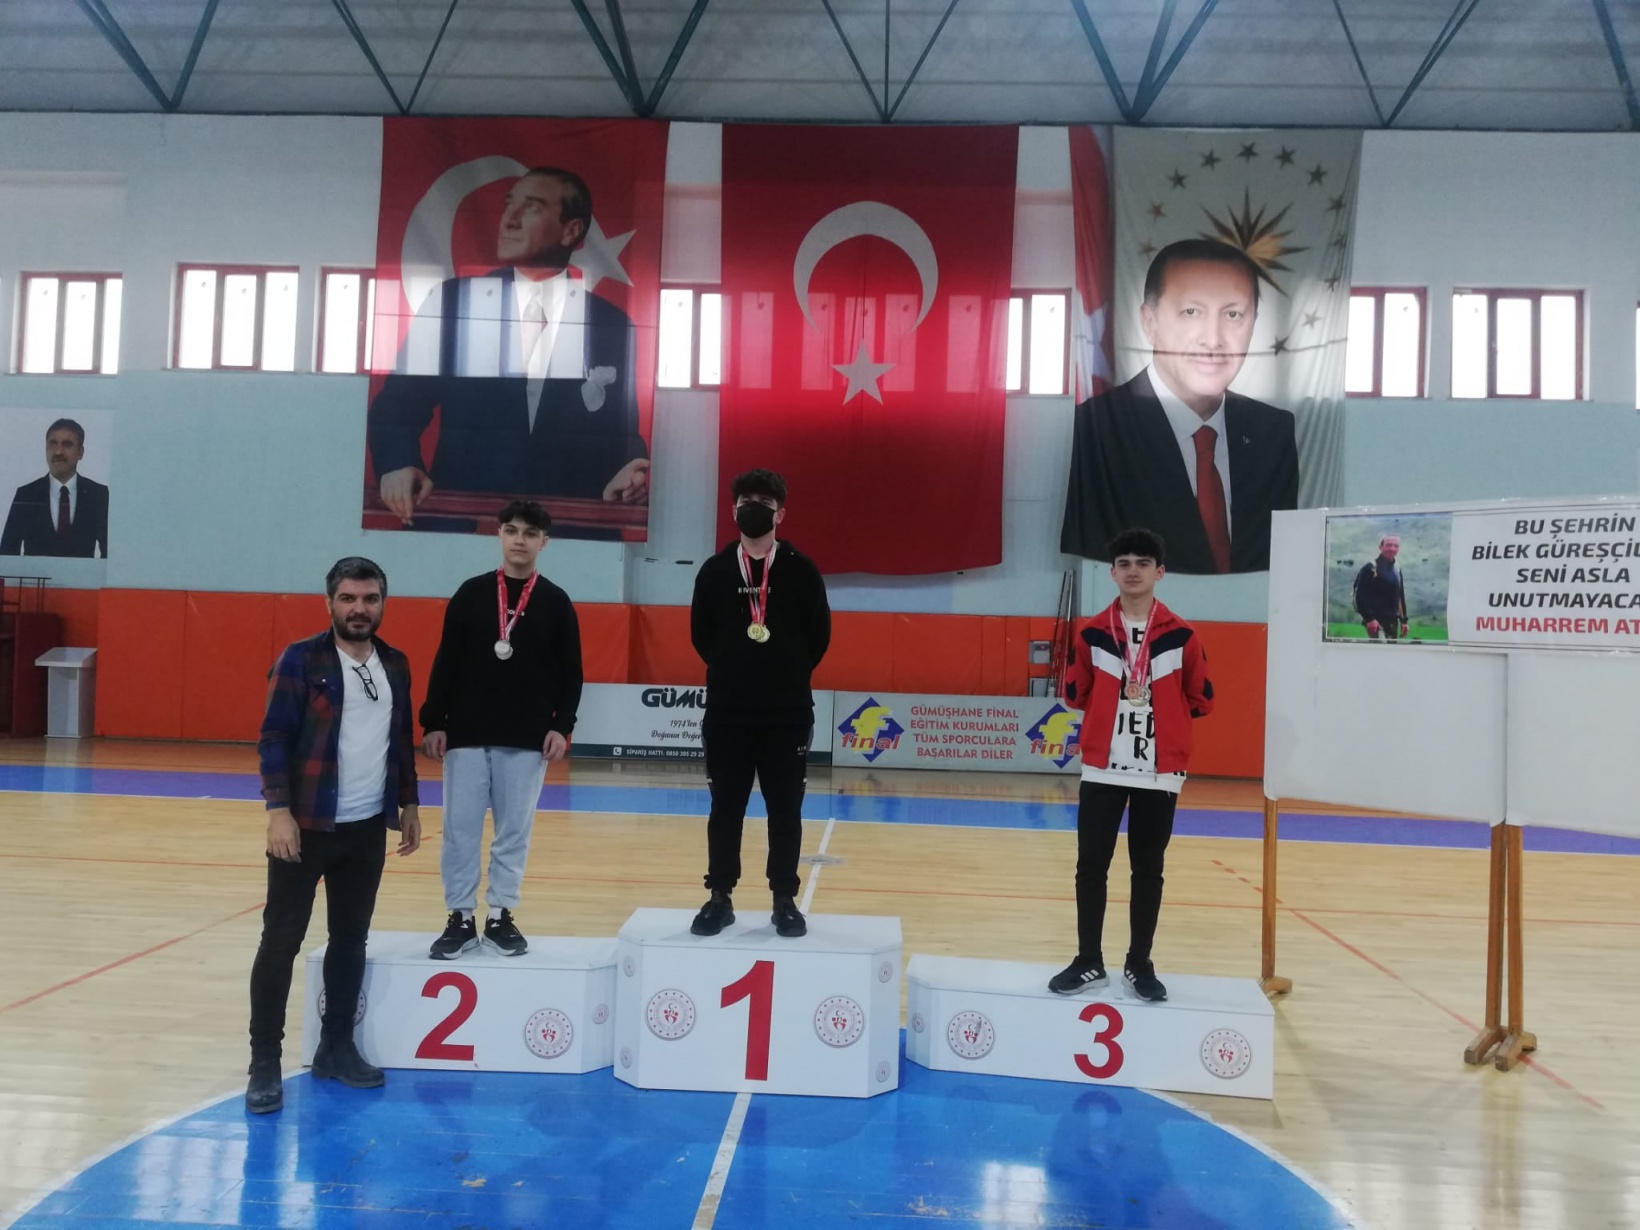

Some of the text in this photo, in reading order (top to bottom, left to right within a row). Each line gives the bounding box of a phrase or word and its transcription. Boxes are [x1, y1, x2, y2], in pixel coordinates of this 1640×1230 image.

[1514, 513, 1636, 539] BU ŞEHRİN
[1472, 541, 1531, 560] BİLEK
[1516, 564, 1631, 583] SENİ ASLA
[1488, 592, 1640, 609] UNUTMAYACA
[1476, 616, 1609, 634] MUHARREM
[911, 704, 1019, 719] GÜMÜŞHANE FİNAL
[910, 718, 1019, 732] EĞİTİM KURUMLARI
[841, 732, 900, 750] final
[913, 731, 1017, 746] TÜM SPORCULARA
[917, 747, 1013, 760] BAŞARILAR DİLER
[414, 971, 478, 1061] 2
[720, 960, 775, 1082] 1
[1073, 1002, 1124, 1079] 3
